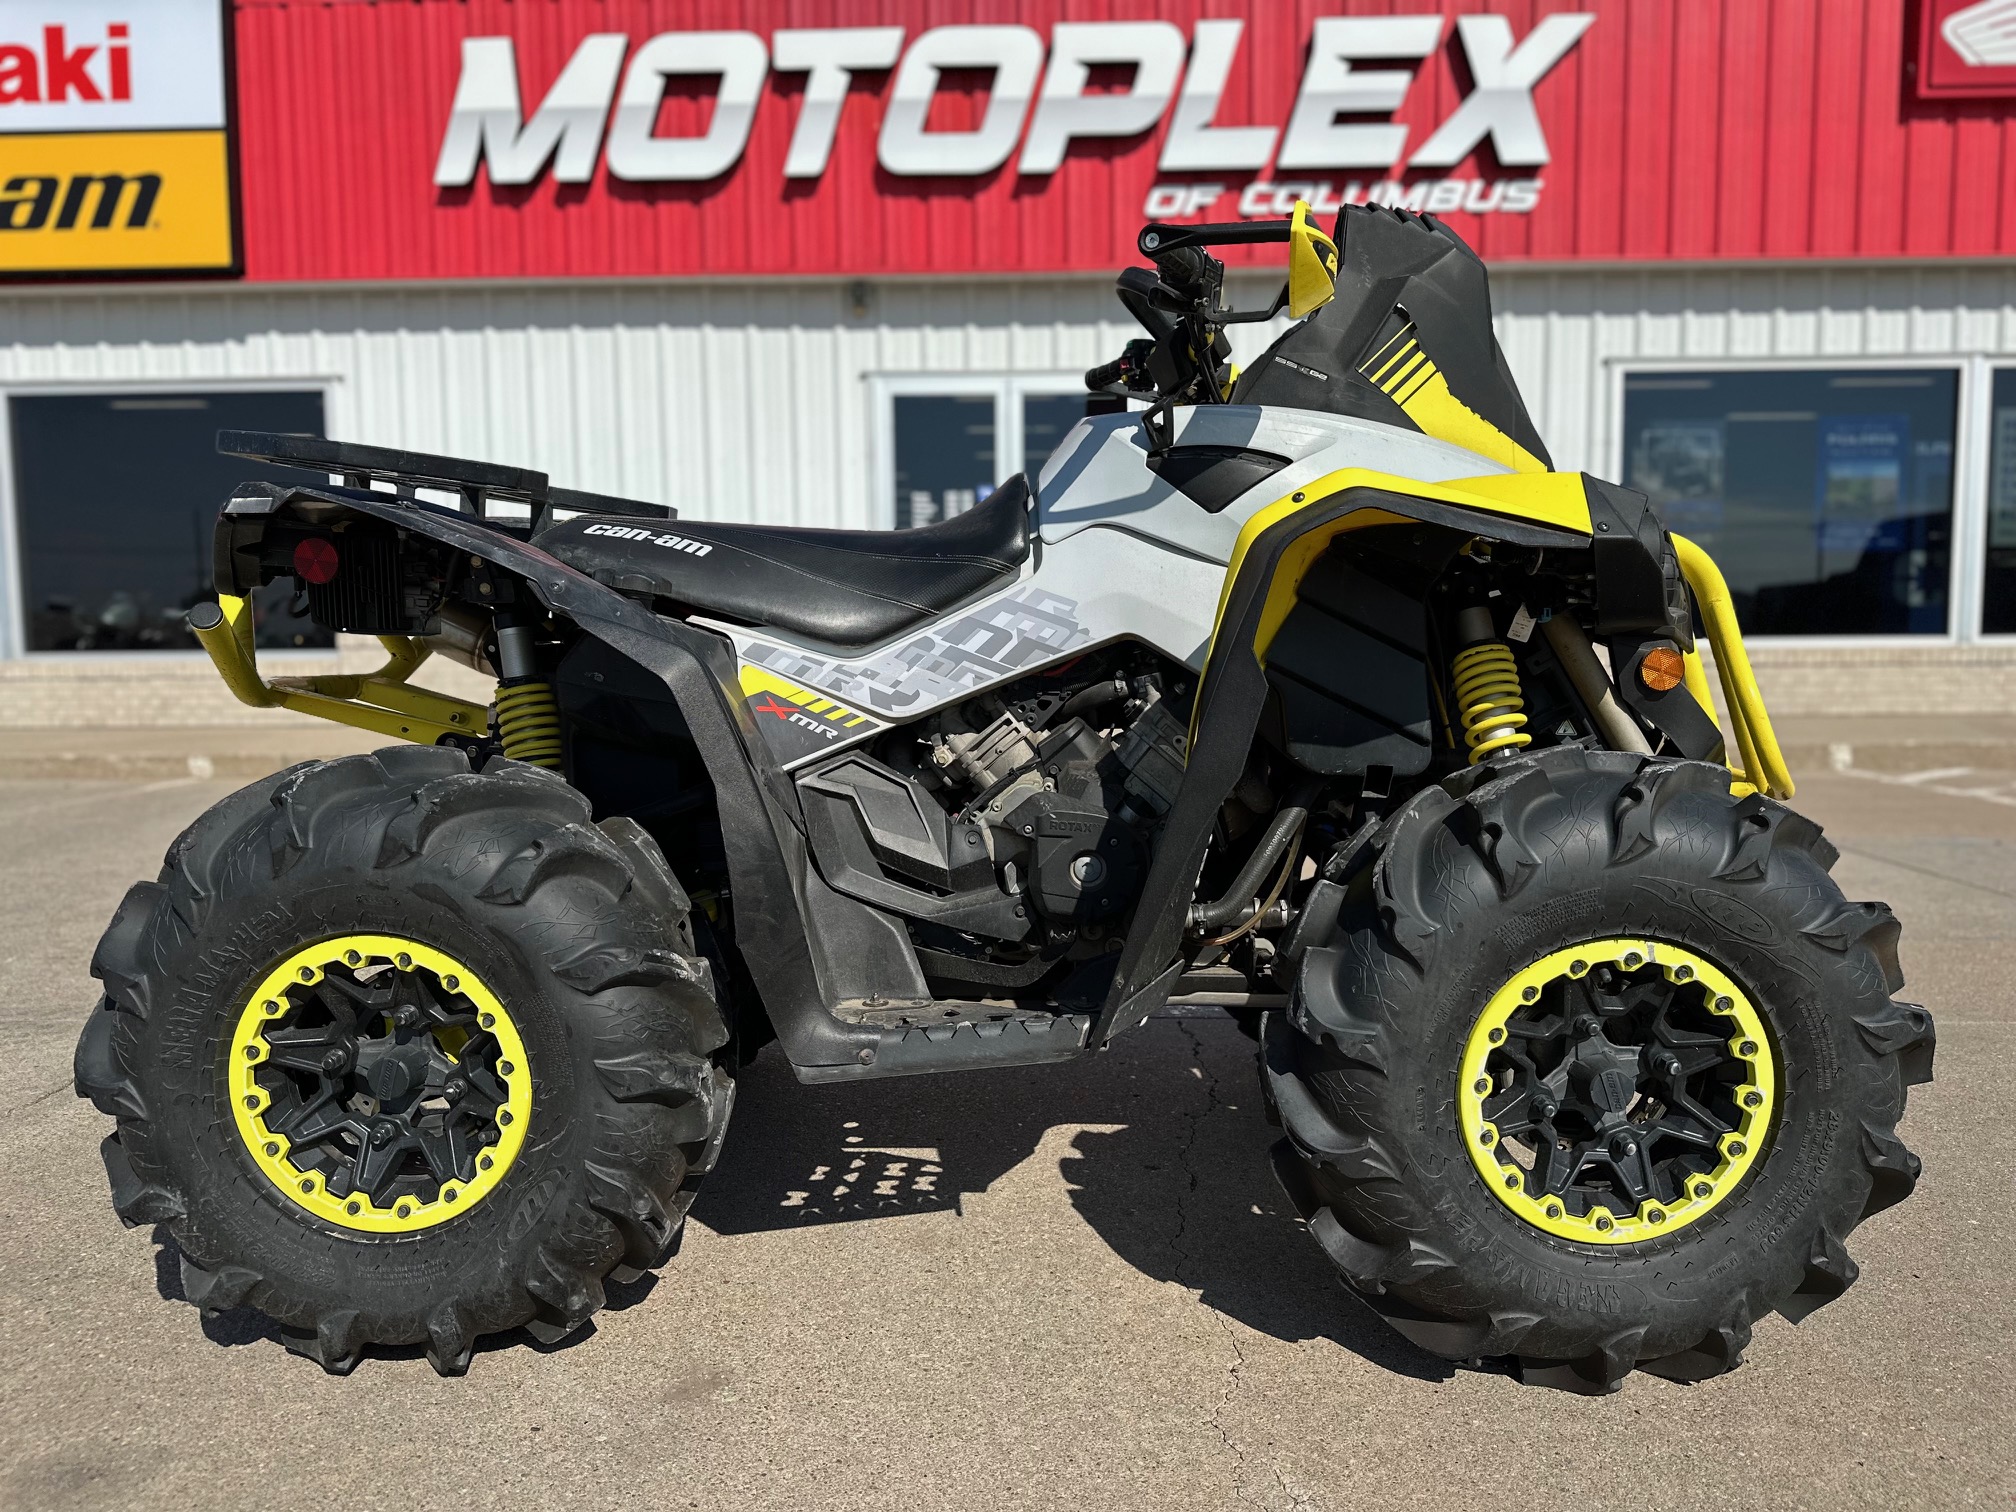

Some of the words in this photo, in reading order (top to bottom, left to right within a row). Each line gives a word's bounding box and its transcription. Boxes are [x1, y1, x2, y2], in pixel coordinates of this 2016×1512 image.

[0, 23, 132, 105] aki
[434, 13, 1596, 186] MOTOPLEX
[0, 172, 162, 231] am
[1144, 184, 1224, 219] OF
[1239, 178, 1544, 217] COLUMBUS
[582, 524, 713, 557] can-am
[1049, 819, 1094, 836] ROTAX
